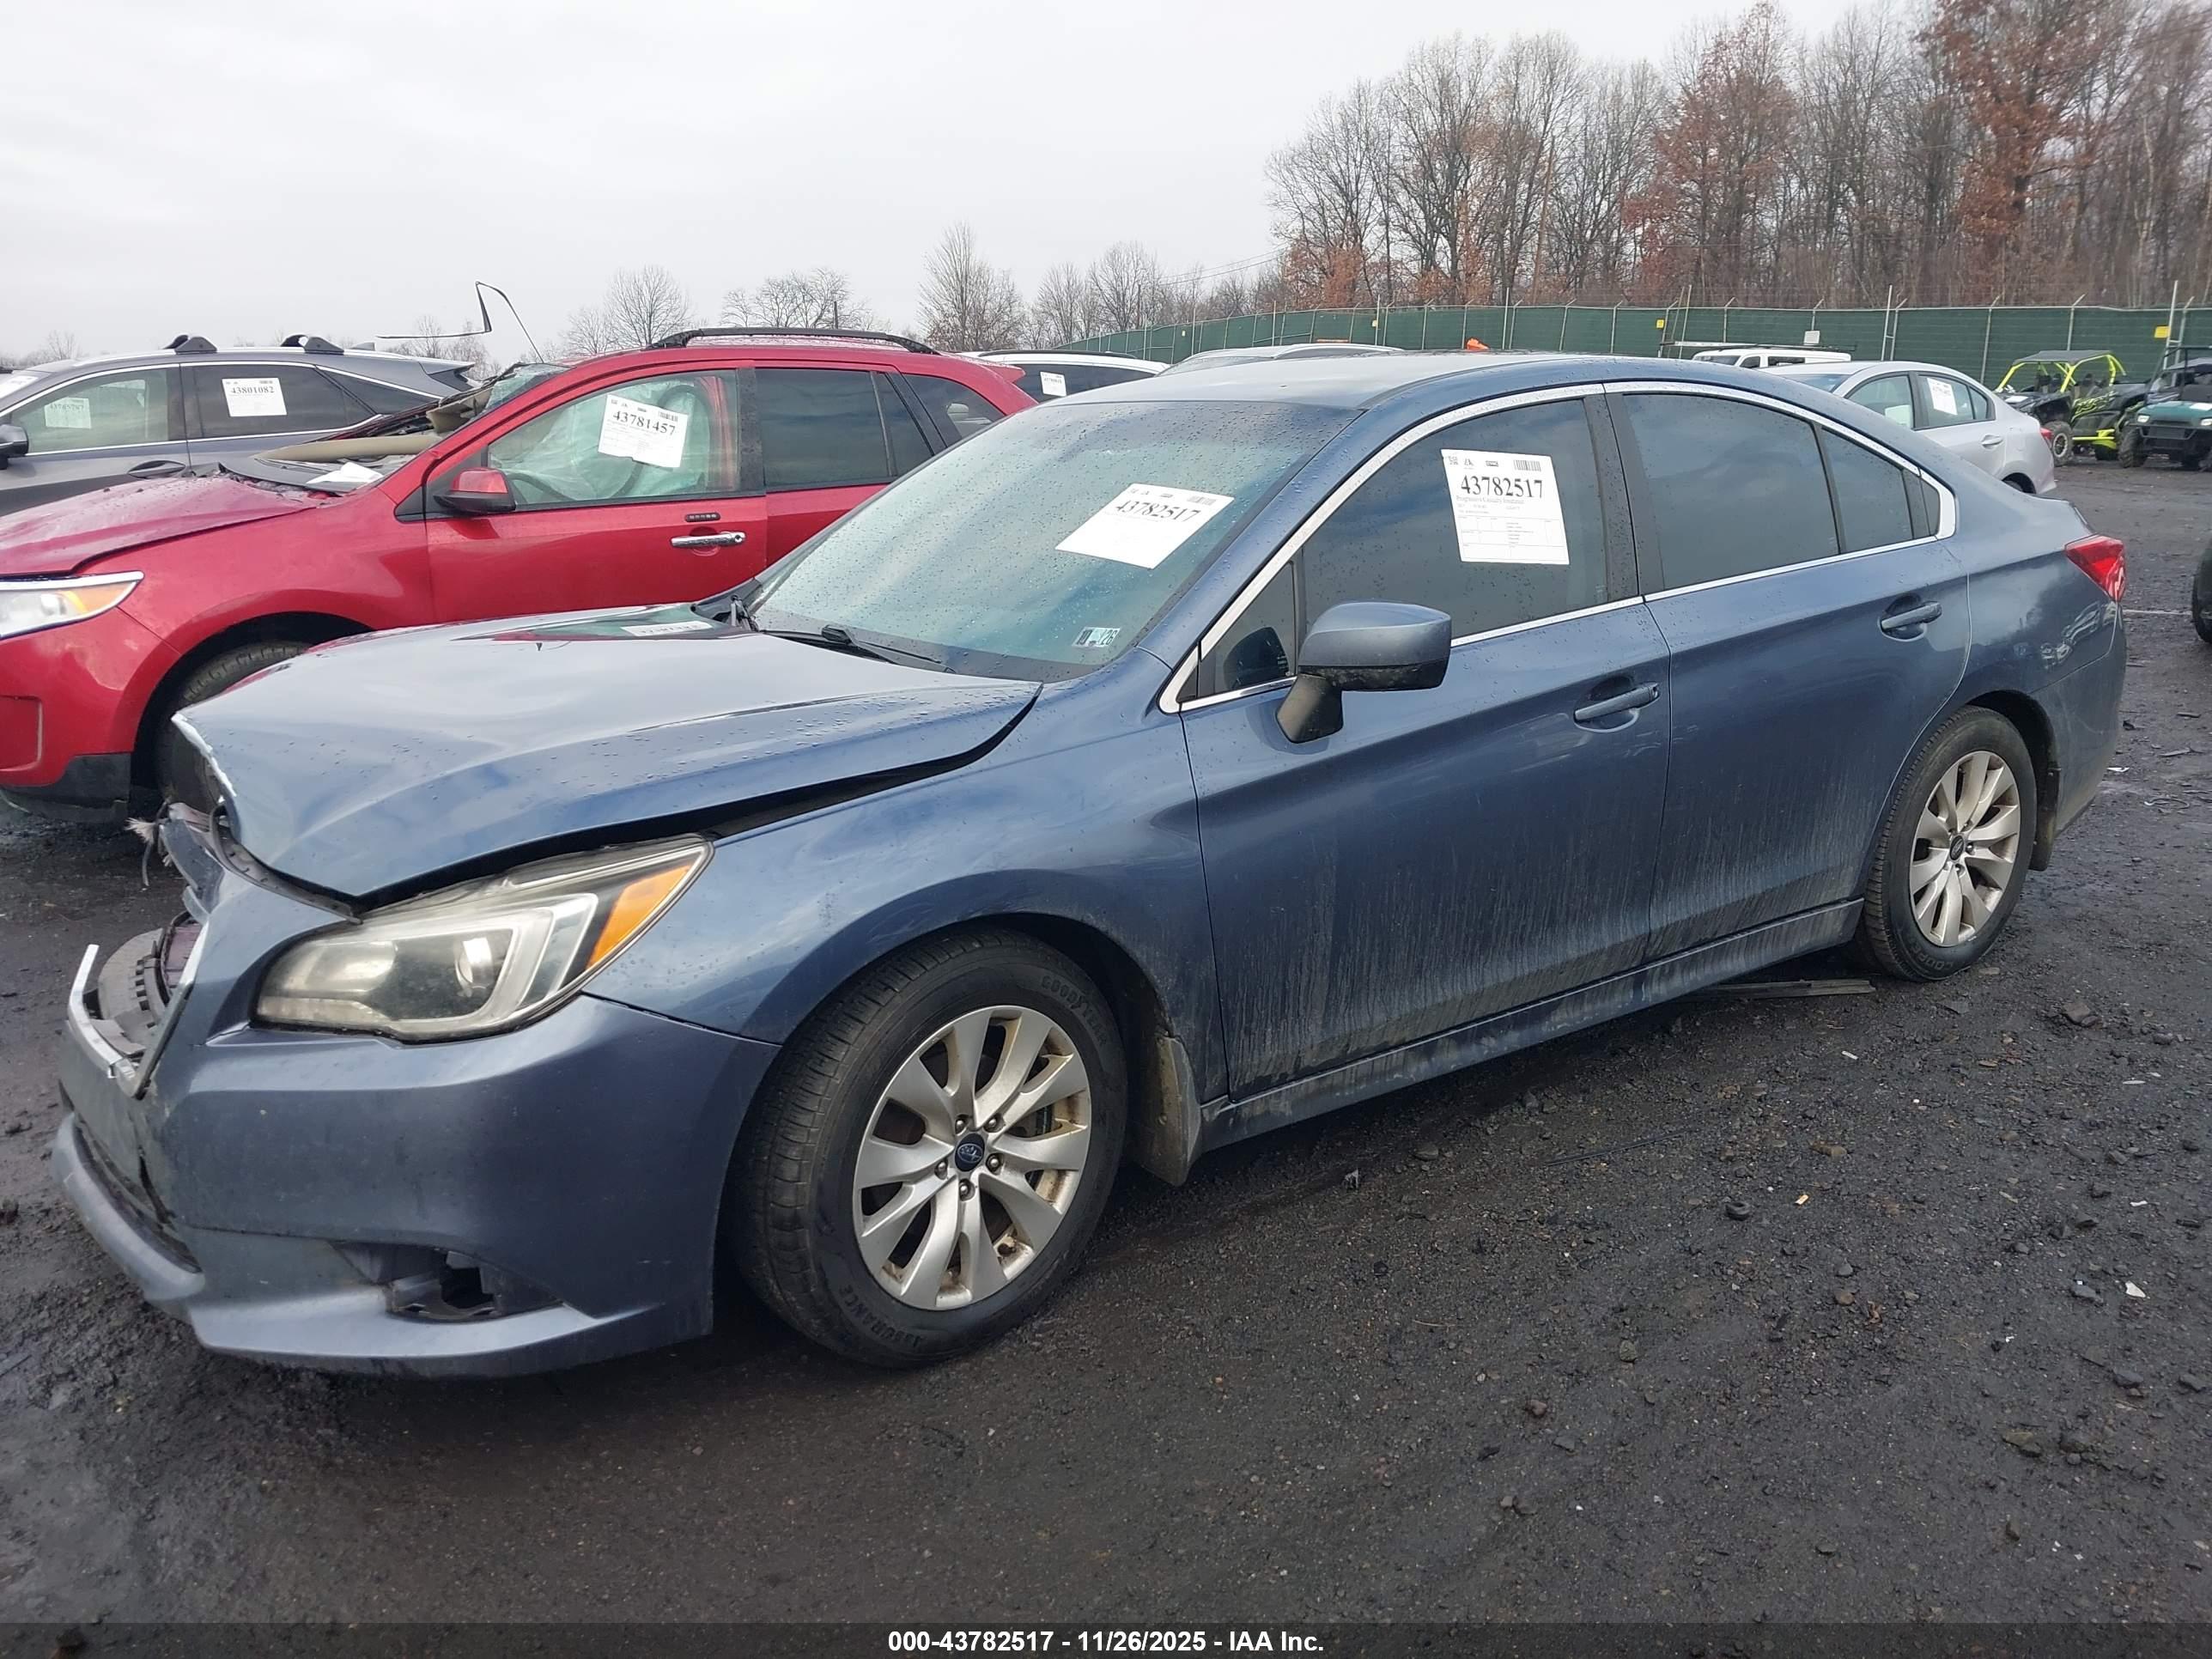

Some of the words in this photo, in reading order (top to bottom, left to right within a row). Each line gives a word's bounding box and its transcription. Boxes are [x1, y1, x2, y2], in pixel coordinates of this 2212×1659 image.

[231, 386, 275, 394] 43801082
[612, 410, 677, 436] 43781457
[1461, 475, 1542, 498] 43782517
[1115, 499, 1202, 522] 43782517
[1041, 974, 1107, 1047] GOODYEAR
